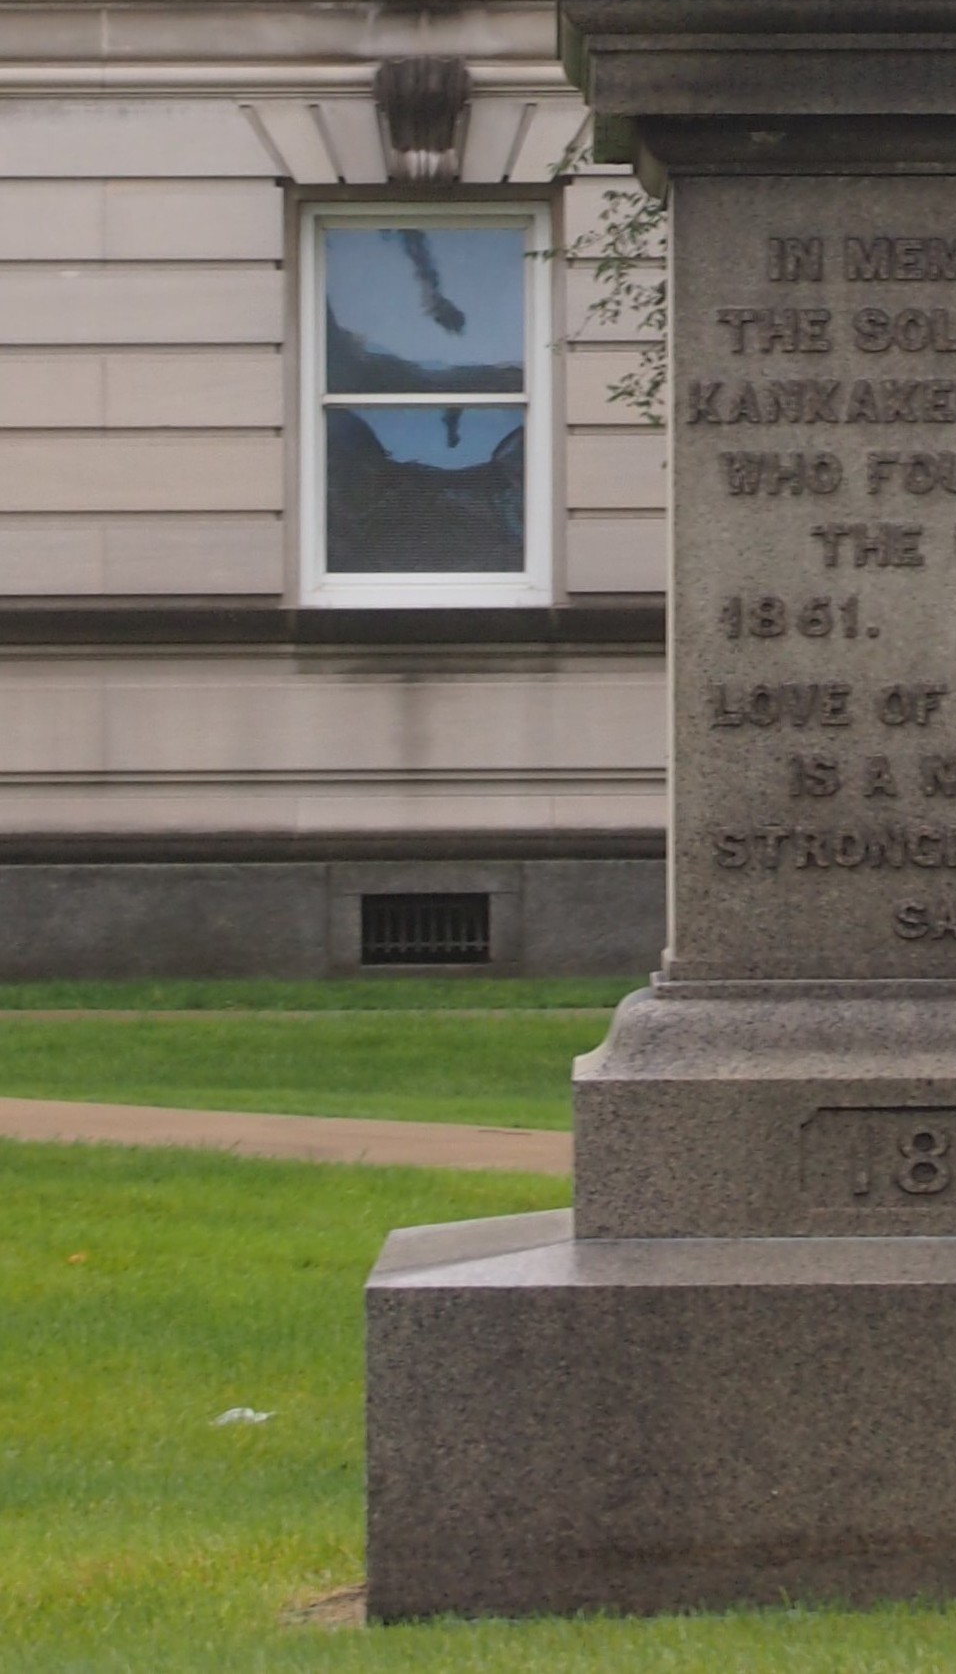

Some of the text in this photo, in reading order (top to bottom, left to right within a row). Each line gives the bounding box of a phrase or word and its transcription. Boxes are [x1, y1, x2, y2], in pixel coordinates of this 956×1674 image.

[768, 237, 823, 280] IN
[716, 307, 831, 353] THE
[720, 450, 843, 496] WHO
[811, 523, 926, 568] THE
[717, 595, 882, 639] 1861.
[711, 682, 853, 726] LOVE
[877, 682, 948, 726] OF
[788, 752, 841, 798] IS
[863, 753, 898, 797] A
